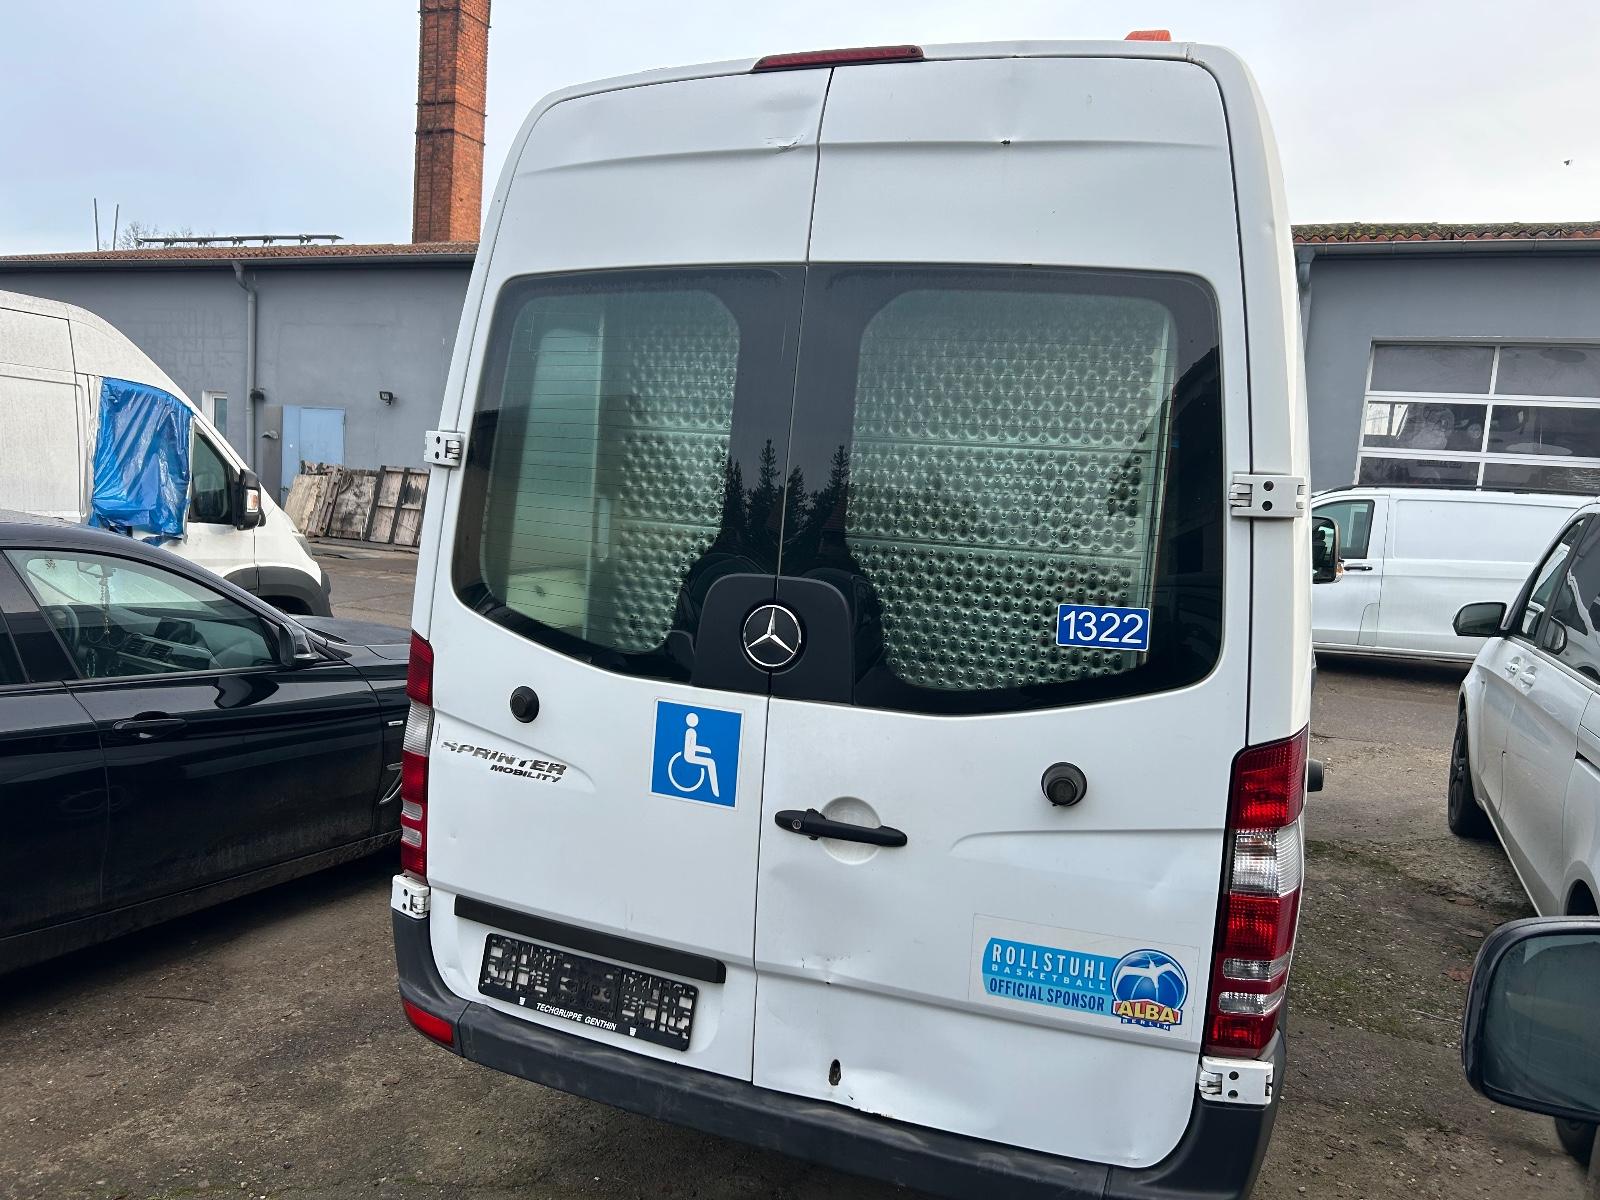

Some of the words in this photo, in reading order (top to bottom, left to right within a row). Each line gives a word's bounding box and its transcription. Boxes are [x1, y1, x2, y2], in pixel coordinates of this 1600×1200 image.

[1063, 610, 1143, 644] 1322
[441, 741, 567, 775] SPRINTER
[490, 764, 562, 782] MOBILITY
[992, 943, 1106, 981] ROLLSTUHL
[991, 963, 1106, 991] BASKETBALL
[989, 977, 1043, 1002] OFFICIAL
[1048, 987, 1105, 1012] SPONSOR
[536, 1002, 583, 1022] TECHGRUPPE
[584, 1015, 617, 1031] GENTHIN
[1118, 1000, 1175, 1024] ALBA
[1122, 1018, 1170, 1031] BERLIN
